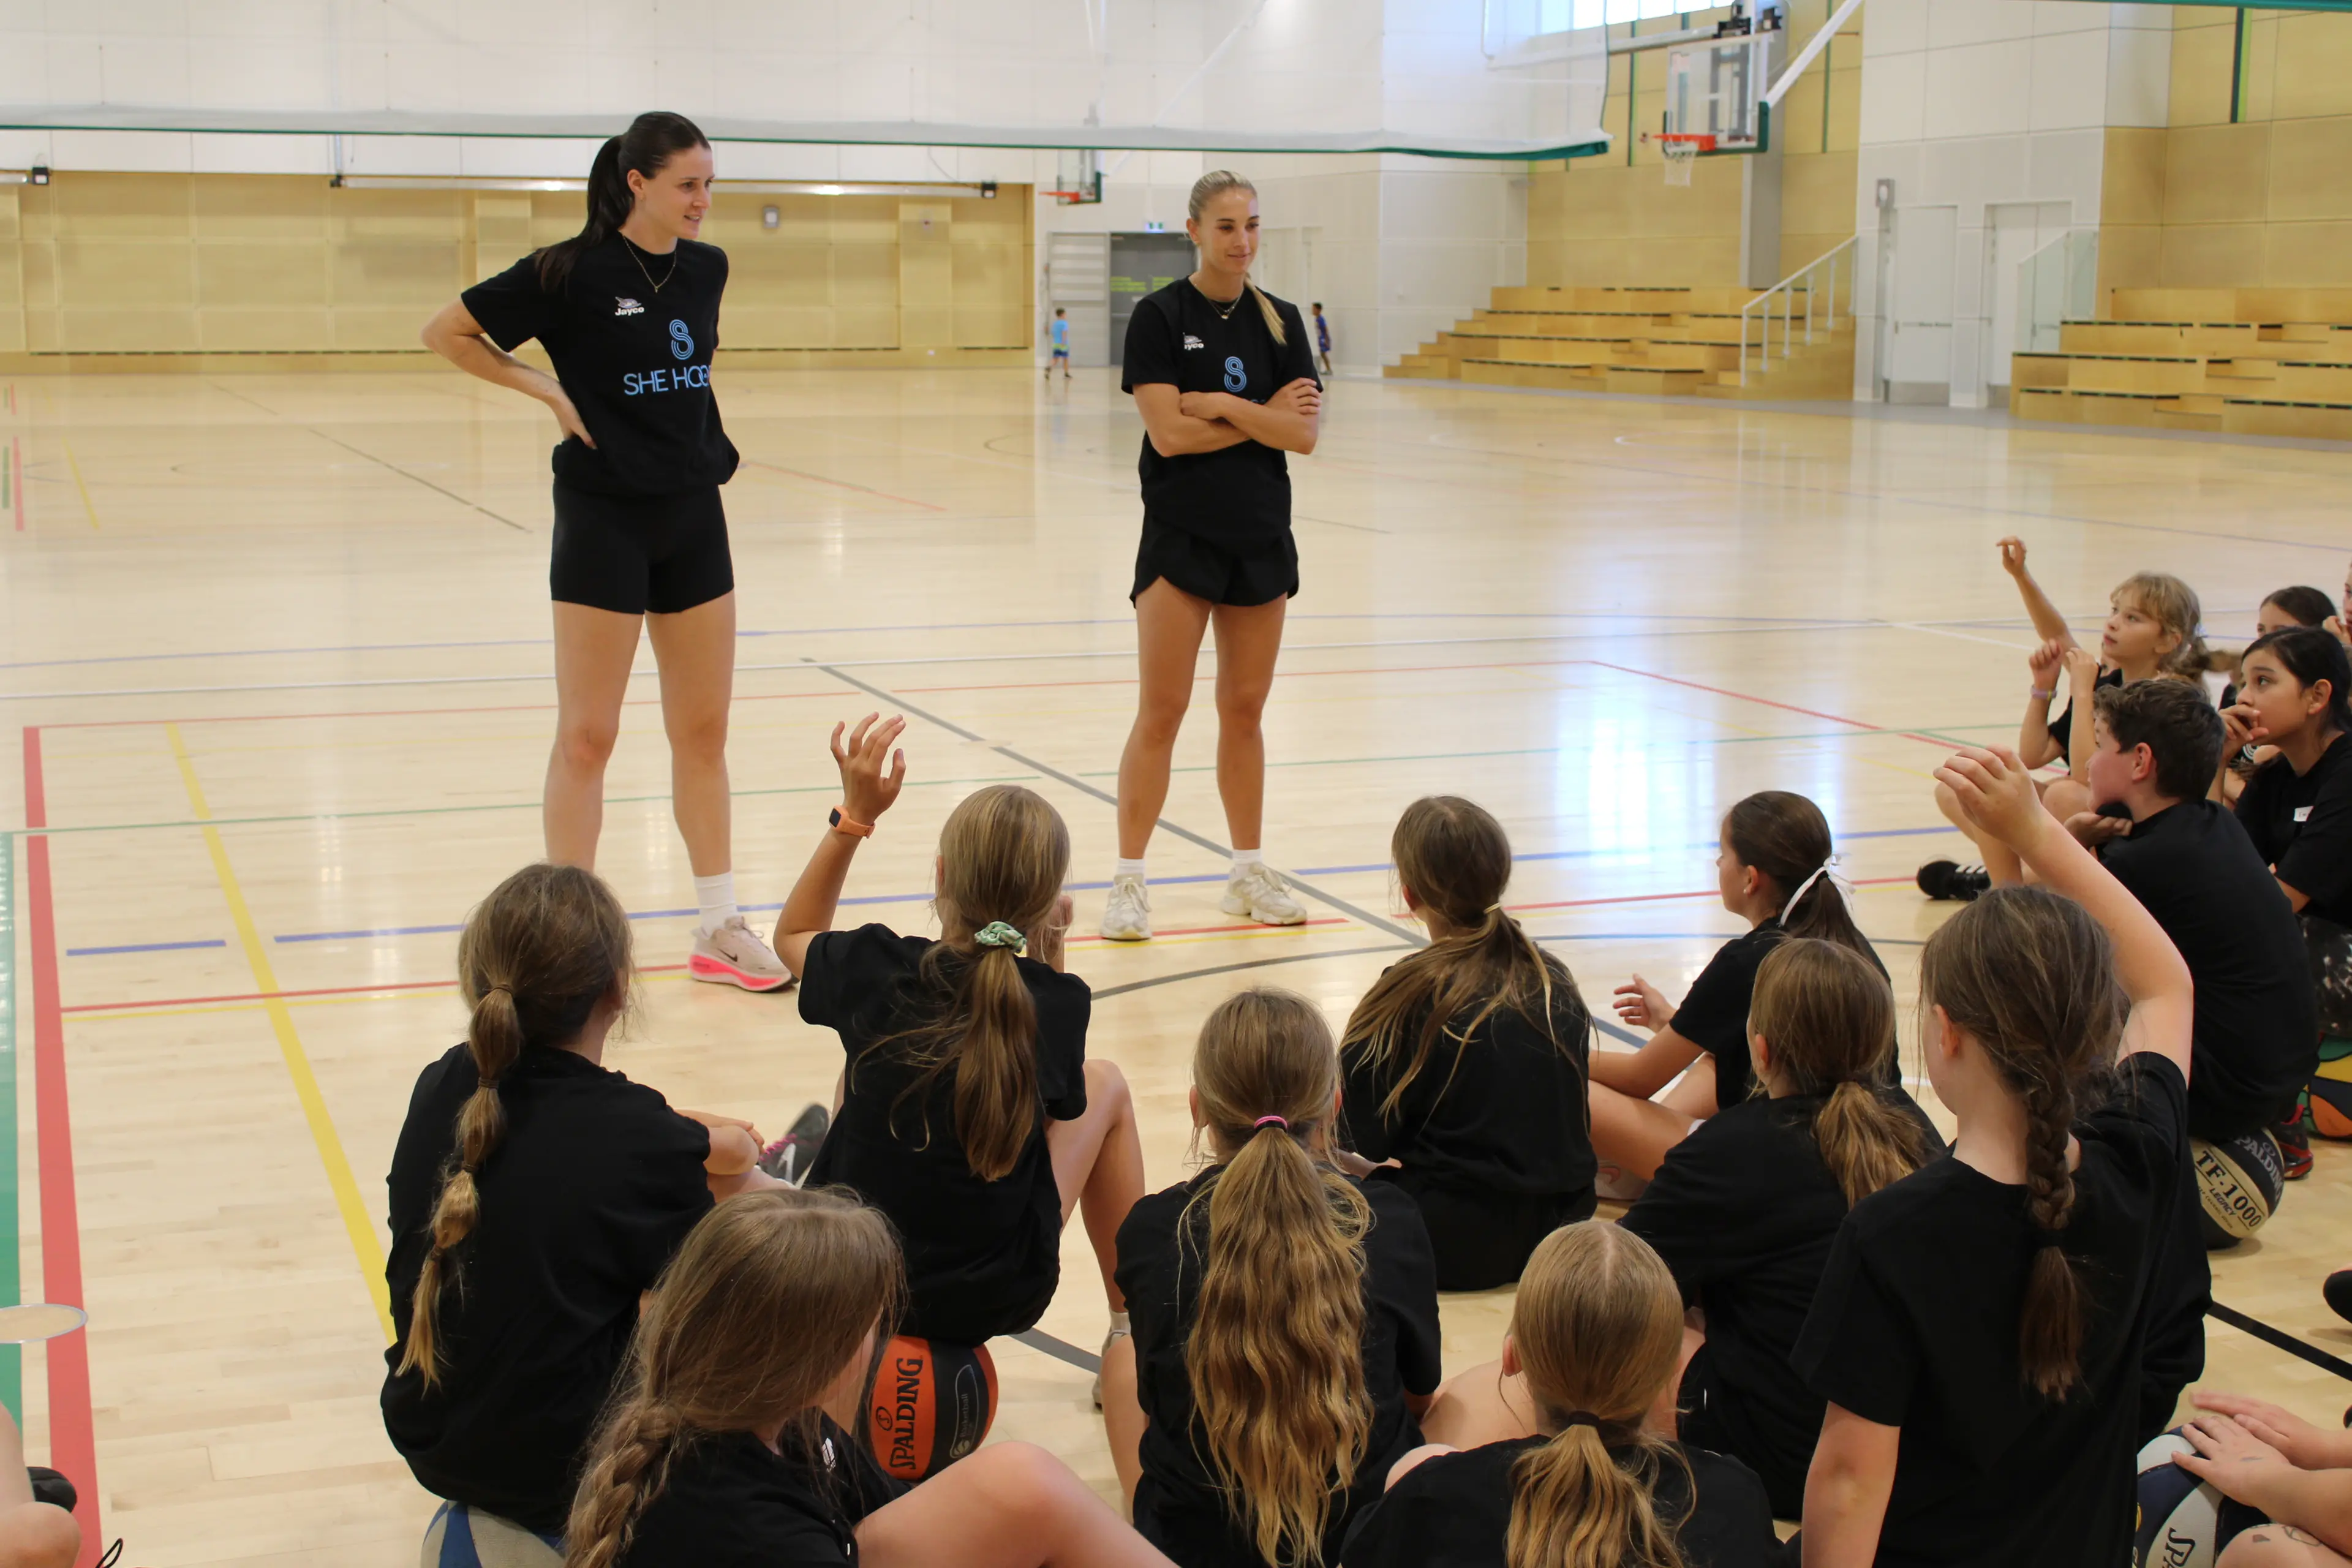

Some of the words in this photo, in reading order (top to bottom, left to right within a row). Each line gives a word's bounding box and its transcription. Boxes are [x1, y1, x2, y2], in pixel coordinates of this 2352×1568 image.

[614, 306, 645, 317] Jayco
[1184, 342, 1204, 351] yco
[624, 369, 669, 396] SHE
[672, 365, 711, 390] HOO
[2209, 1188, 2236, 1216] LEGACY
[889, 1357, 924, 1469] SPALDING
